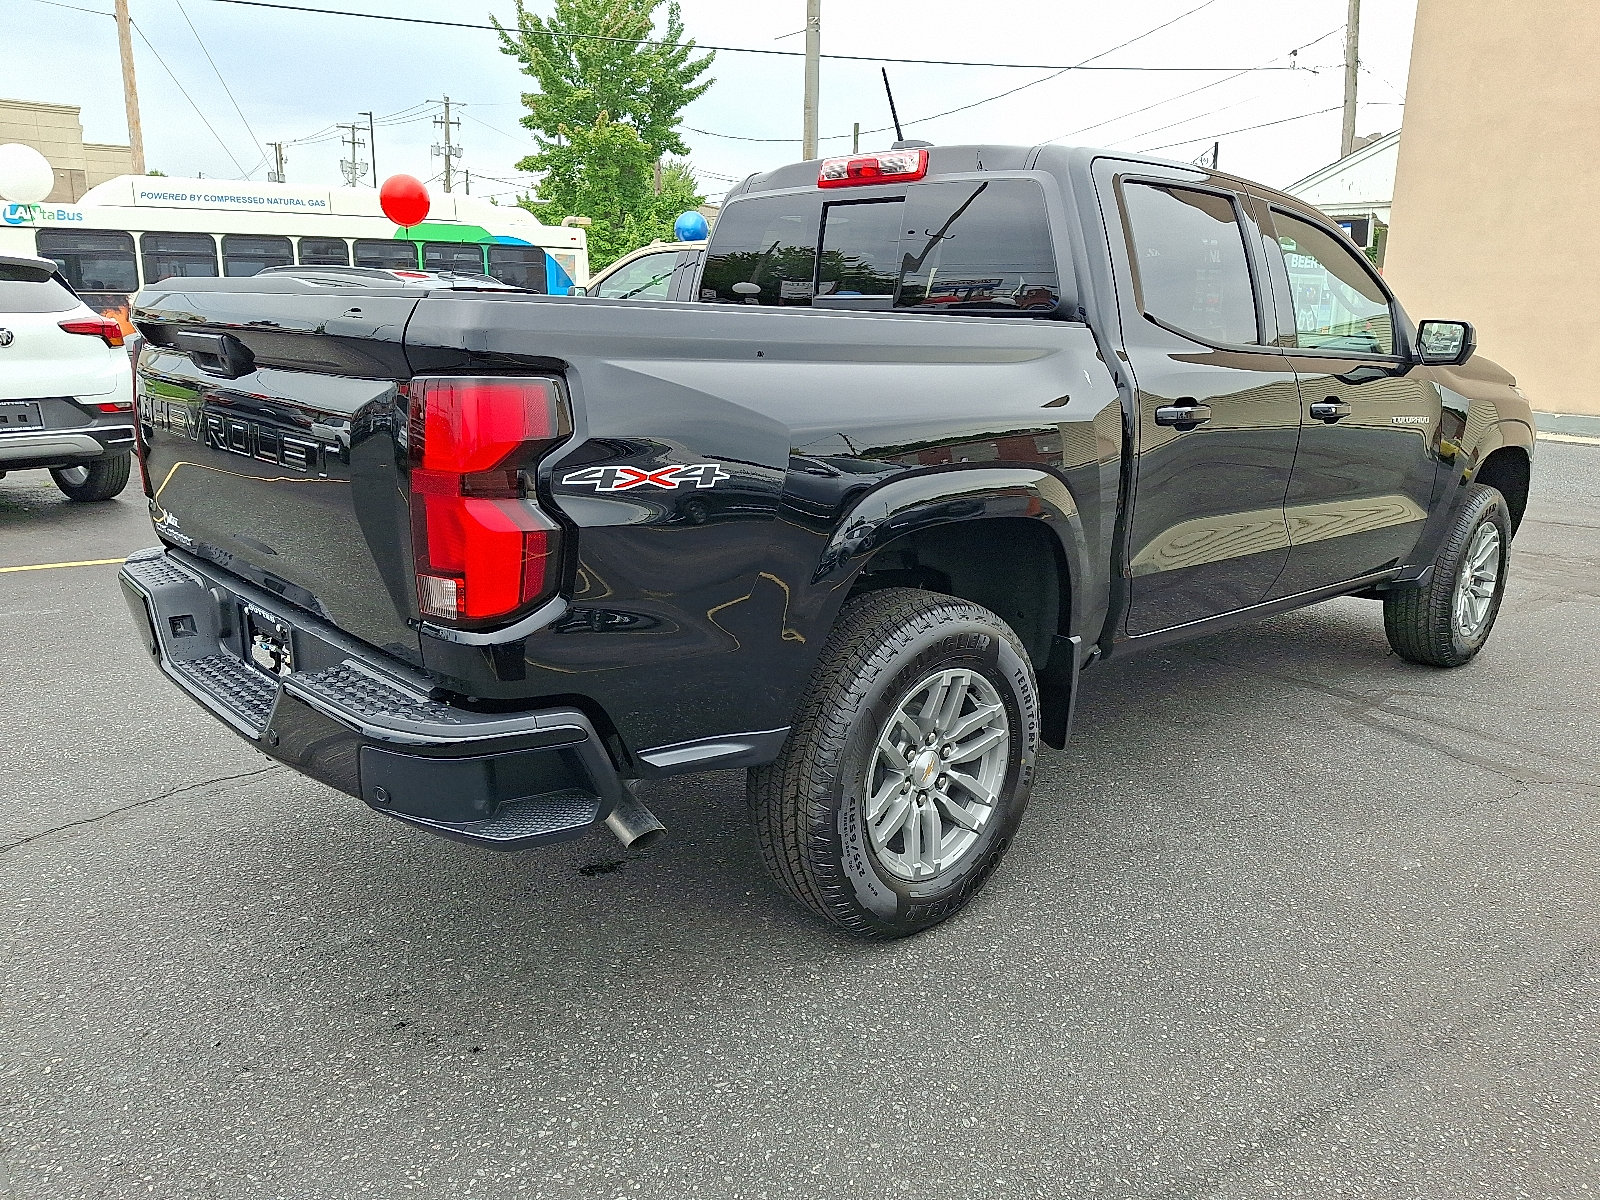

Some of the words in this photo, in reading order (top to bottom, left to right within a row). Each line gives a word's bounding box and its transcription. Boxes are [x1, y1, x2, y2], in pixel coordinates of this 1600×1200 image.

[140, 191, 188, 201] POWERED
[189, 194, 202, 202] BY
[203, 194, 265, 204] COMPRESSED
[266, 197, 306, 206] NATURAL
[307, 199, 326, 207] GAS
[138, 394, 341, 478] CHEVROLET
[1013, 668, 1036, 754] TERRITORY
